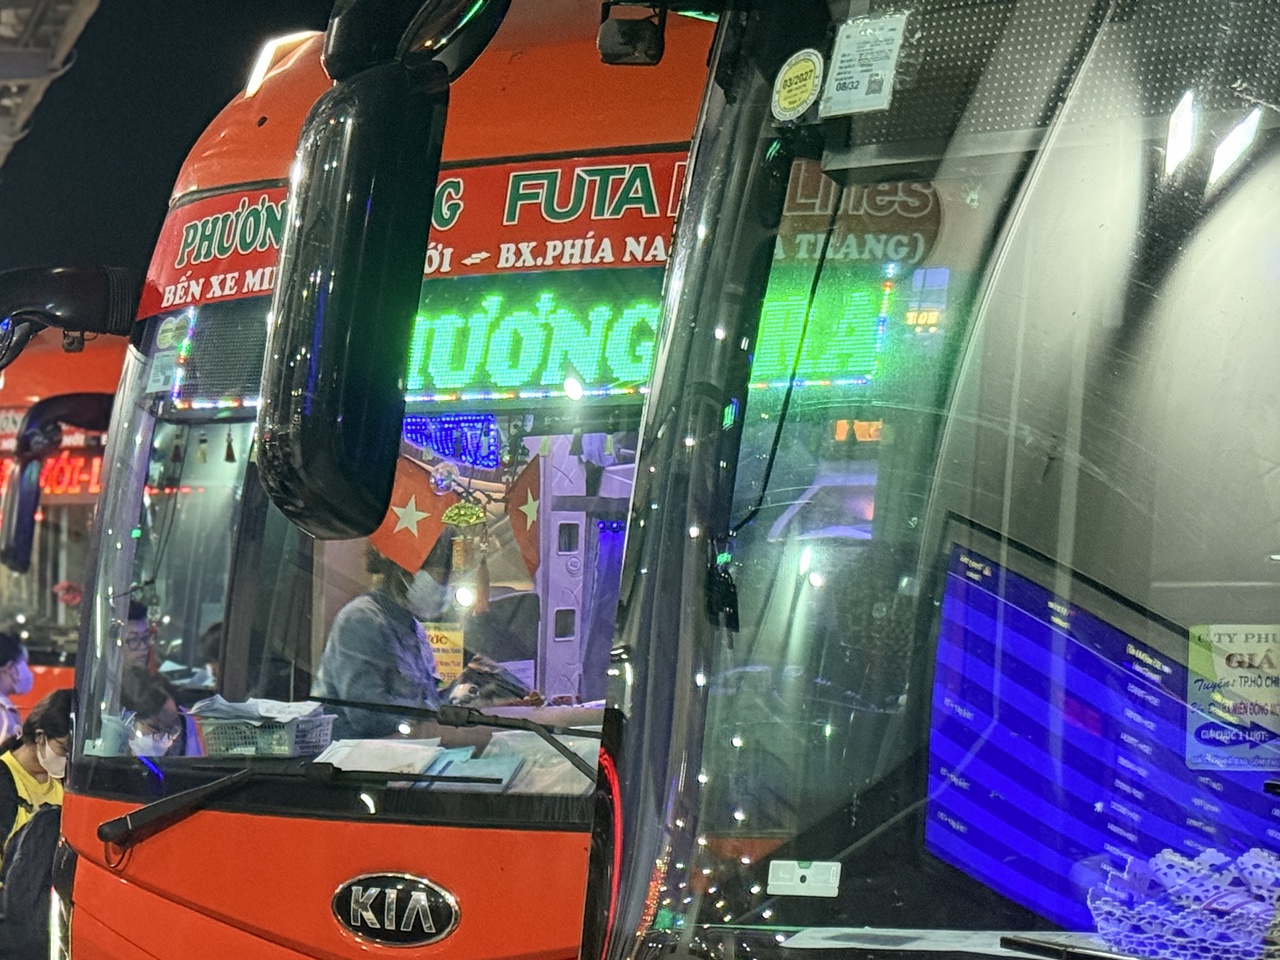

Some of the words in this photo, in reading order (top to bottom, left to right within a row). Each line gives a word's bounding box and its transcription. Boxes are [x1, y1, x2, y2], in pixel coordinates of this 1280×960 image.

[782, 69, 814, 90] 03/2027
[835, 80, 860, 92] 08/32
[174, 195, 288, 269] PHƯƠN
[502, 163, 660, 226] FUTA
[161, 271, 206, 308] BẾN
[206, 274, 238, 299] XE
[424, 242, 454, 274] ỚI
[497, 231, 614, 268] BX.PHÍA
[623, 235, 670, 263] NA
[350, 885, 436, 934] KIA
